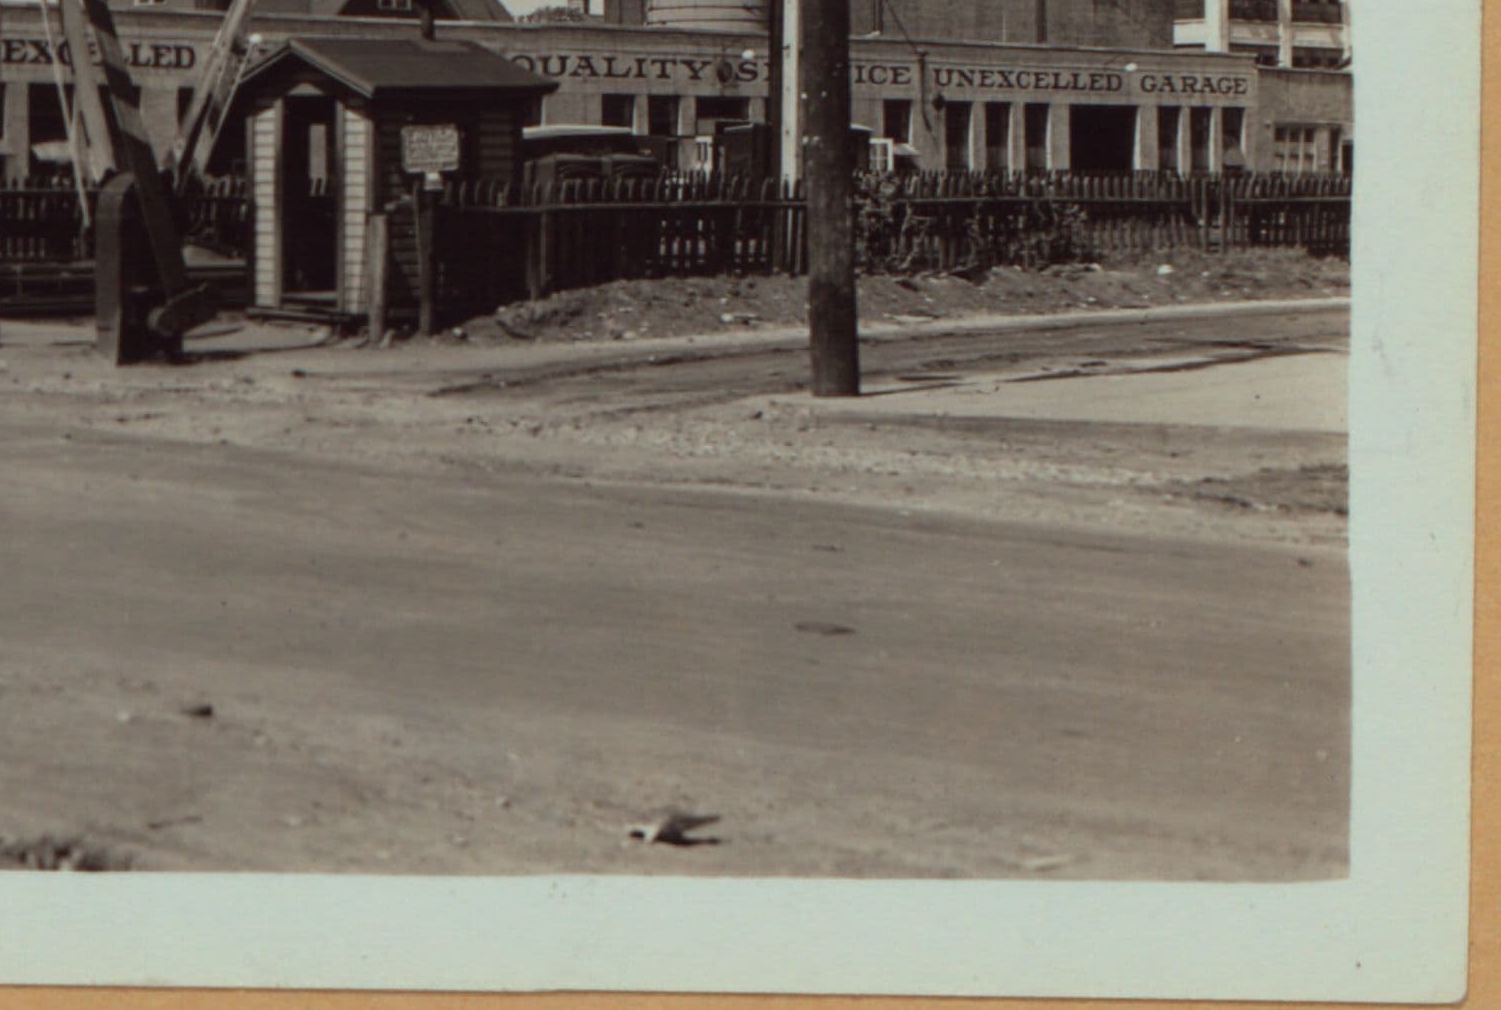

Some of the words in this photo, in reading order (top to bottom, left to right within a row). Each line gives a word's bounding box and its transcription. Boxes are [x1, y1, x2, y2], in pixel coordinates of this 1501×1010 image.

[510, 54, 712, 81] QUALITY
[735, 61, 911, 85] SICE
[933, 66, 1123, 91] UNEXCELLED
[1139, 73, 1248, 95] GARAGE
